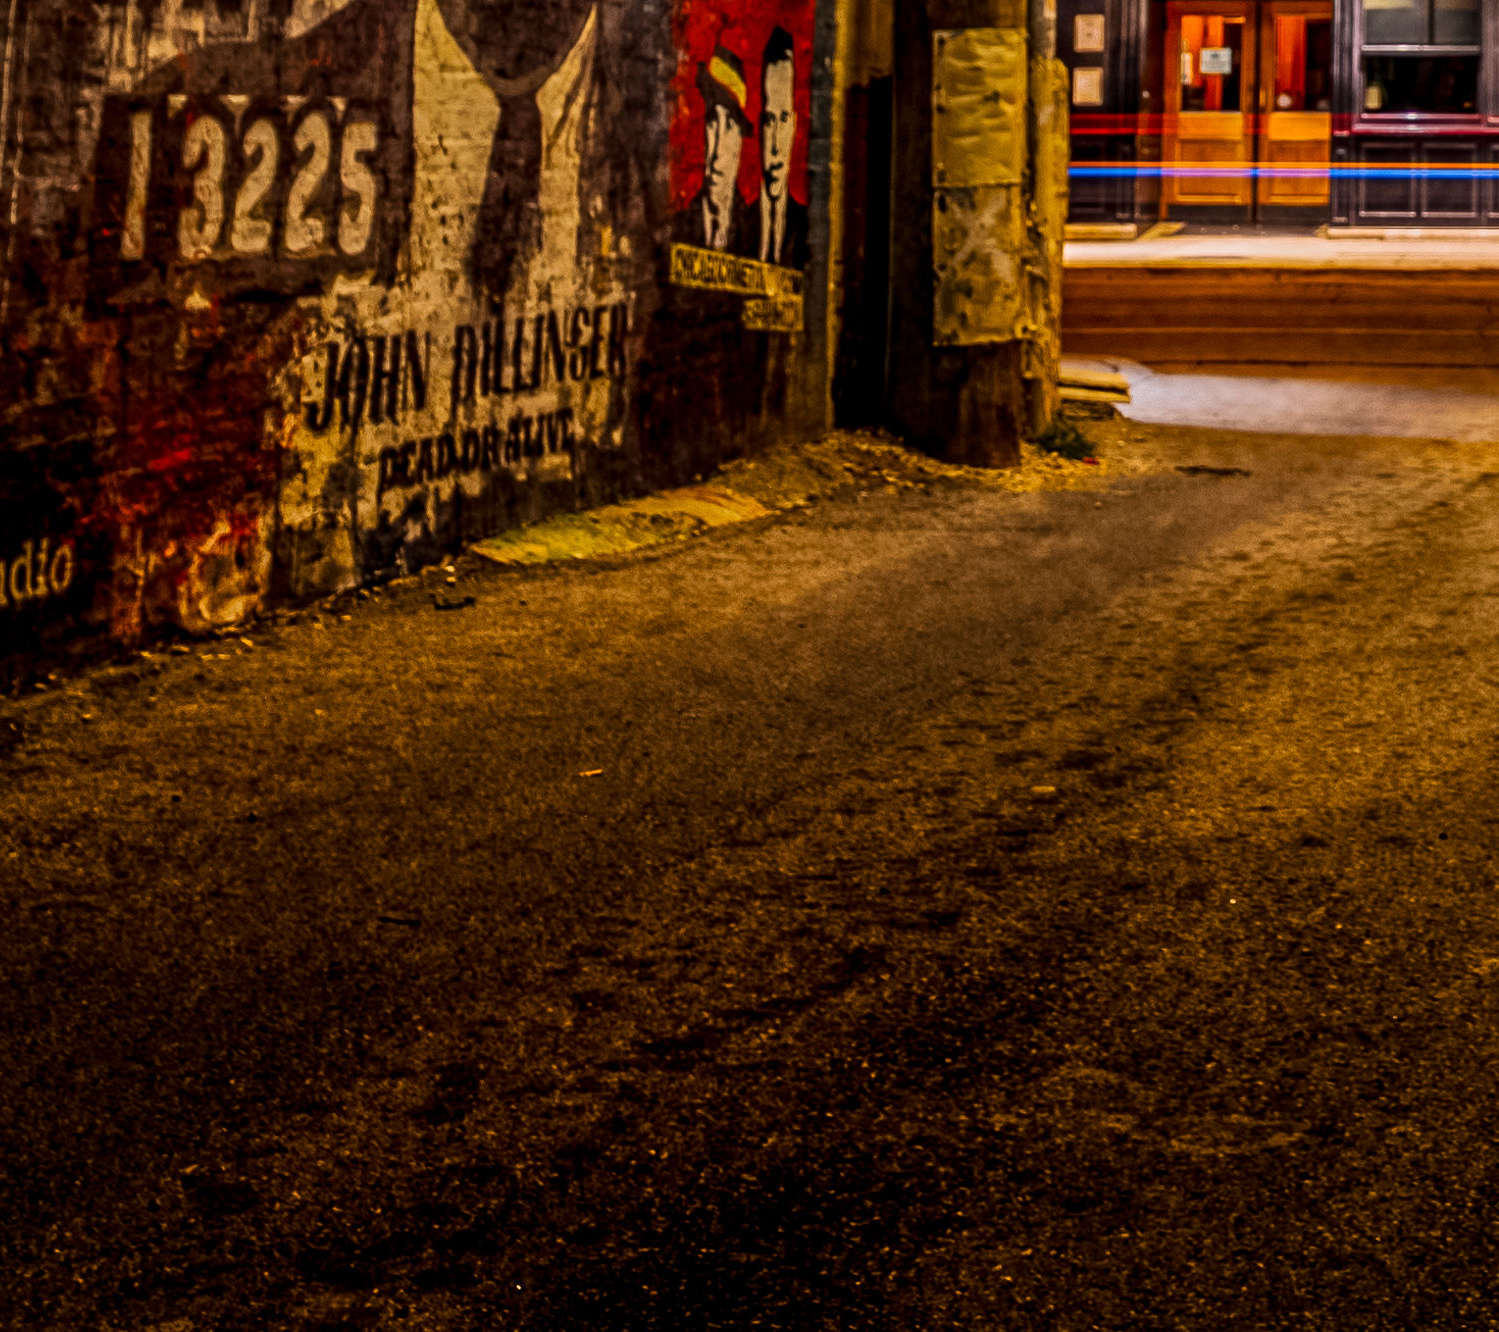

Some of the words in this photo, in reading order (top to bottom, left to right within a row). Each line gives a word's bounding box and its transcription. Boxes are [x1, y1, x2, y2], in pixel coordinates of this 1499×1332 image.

[308, 329, 430, 433] JOHN
[454, 302, 629, 400] DILLINGER
[378, 434, 456, 486] DEAD
